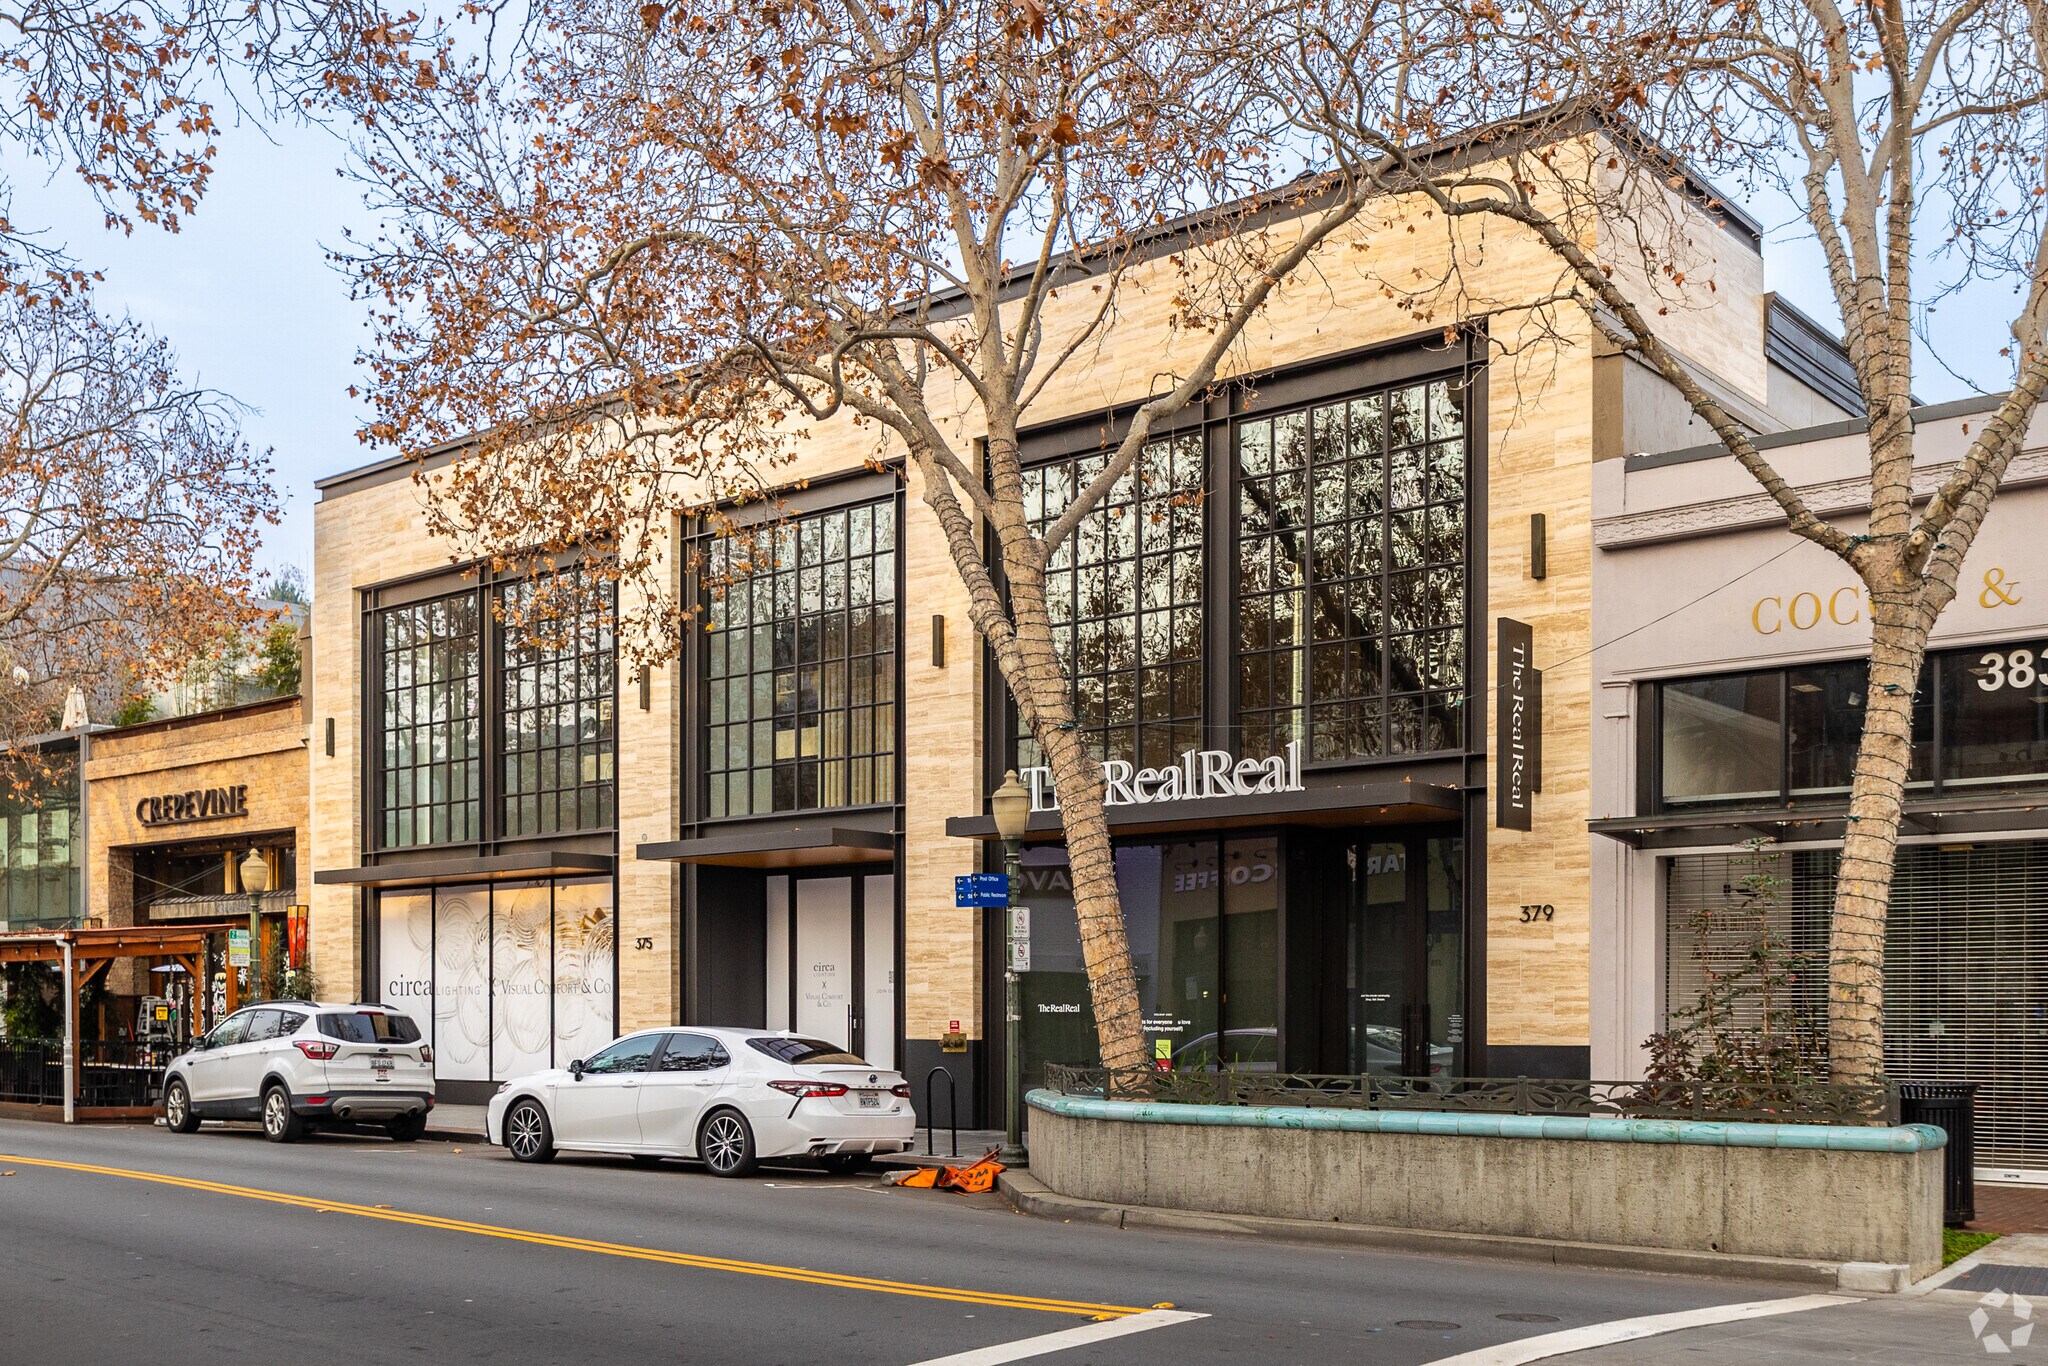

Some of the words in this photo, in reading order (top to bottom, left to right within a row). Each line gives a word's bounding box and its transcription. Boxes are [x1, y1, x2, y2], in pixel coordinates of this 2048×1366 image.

[1979, 567, 2022, 609] &
[136, 784, 249, 826] CREPEVINE
[1519, 904, 1555, 923] 379
[635, 937, 653, 950] 375
[813, 962, 835, 972] circa
[389, 974, 433, 996] circa
[436, 985, 481, 996] LIGHTING
[581, 978, 592, 994] &
